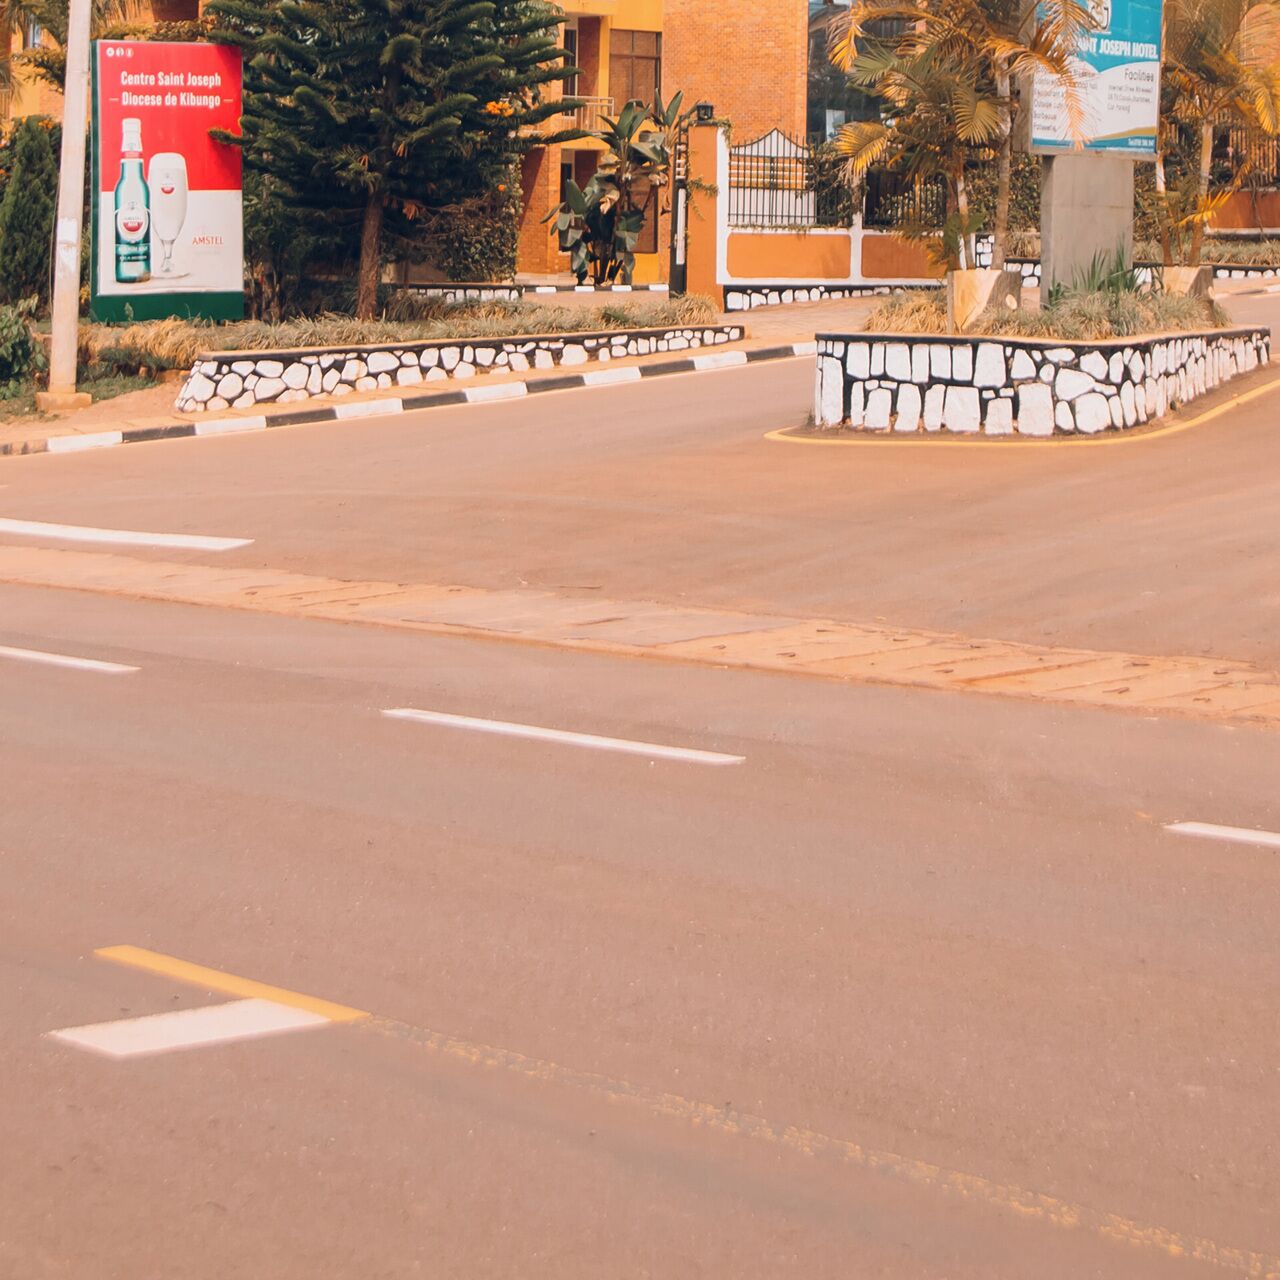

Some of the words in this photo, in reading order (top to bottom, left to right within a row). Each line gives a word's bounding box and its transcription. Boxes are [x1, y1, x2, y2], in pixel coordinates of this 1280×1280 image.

[1099, 38, 1131, 57] JOSEPH
[1132, 41, 1159, 60] HOTEL
[121, 70, 156, 86] Centre
[157, 71, 185, 87] Saint
[186, 71, 222, 89] Joseph
[121, 91, 163, 106] Diocese
[164, 91, 178, 106] de
[179, 91, 221, 109] Kibungo
[192, 236, 224, 246] AMSTEL
